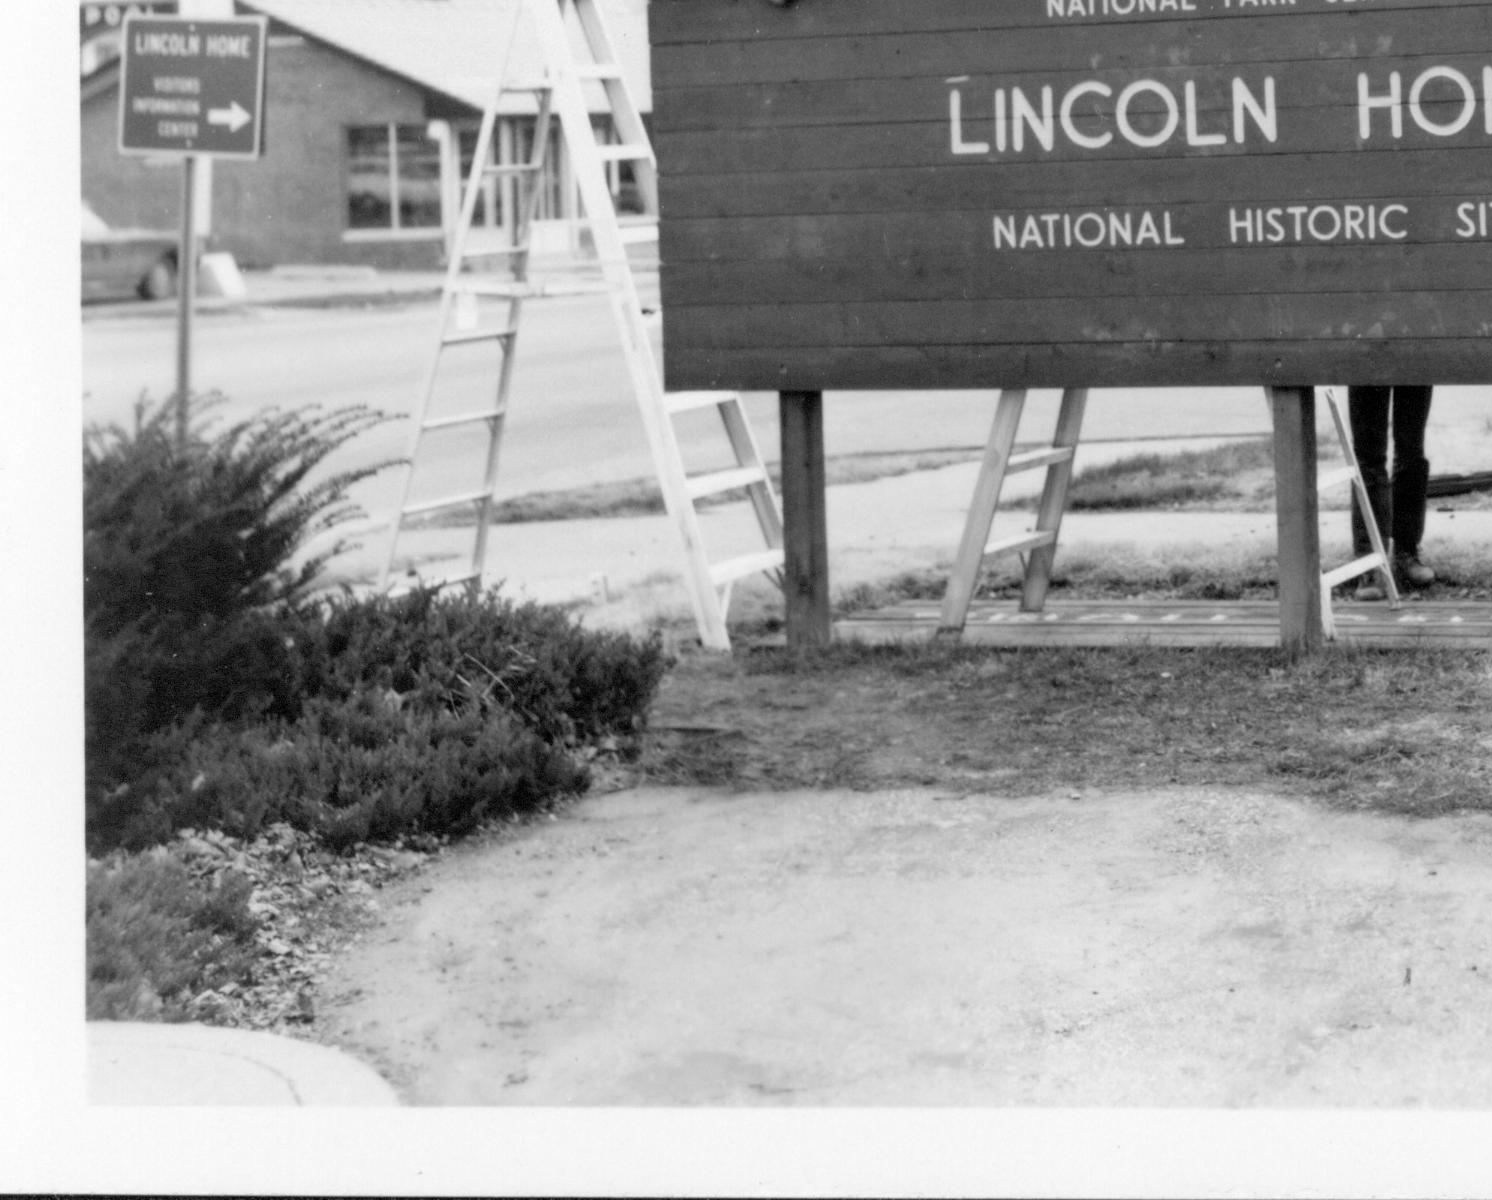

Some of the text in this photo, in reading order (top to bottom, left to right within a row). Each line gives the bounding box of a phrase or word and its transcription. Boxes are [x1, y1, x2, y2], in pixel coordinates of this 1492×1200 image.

[135, 31, 250, 59] LINCOLN HOME
[132, 97, 200, 116] INFORMATION
[948, 76, 1277, 155] LINCOLN
[158, 120, 199, 138] CENTER
[993, 212, 1184, 249] NATIONAL
[1230, 205, 1408, 243] HISTORIC
